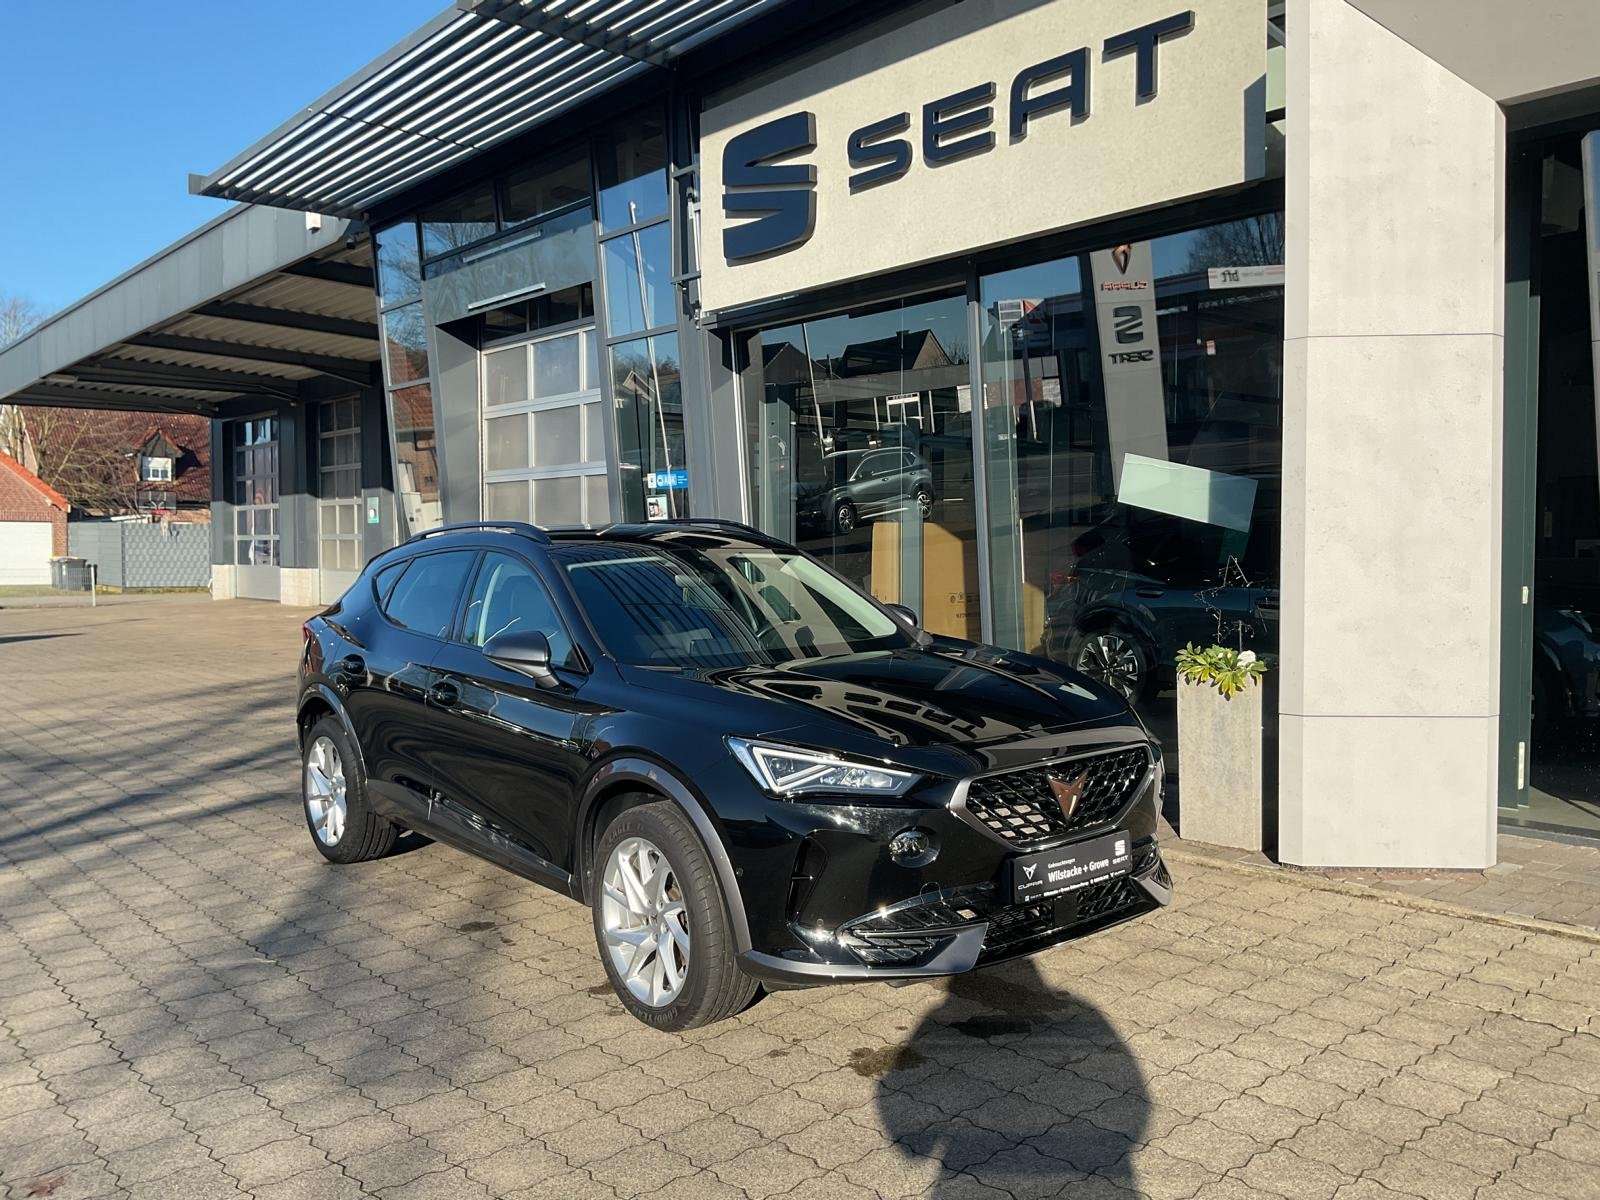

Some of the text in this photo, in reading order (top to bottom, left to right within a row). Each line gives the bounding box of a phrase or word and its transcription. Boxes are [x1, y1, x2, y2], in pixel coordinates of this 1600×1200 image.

[847, 10, 1196, 195] SEAT
[1047, 865, 1082, 882] Wilstacke
[1089, 858, 1110, 871] Growe
